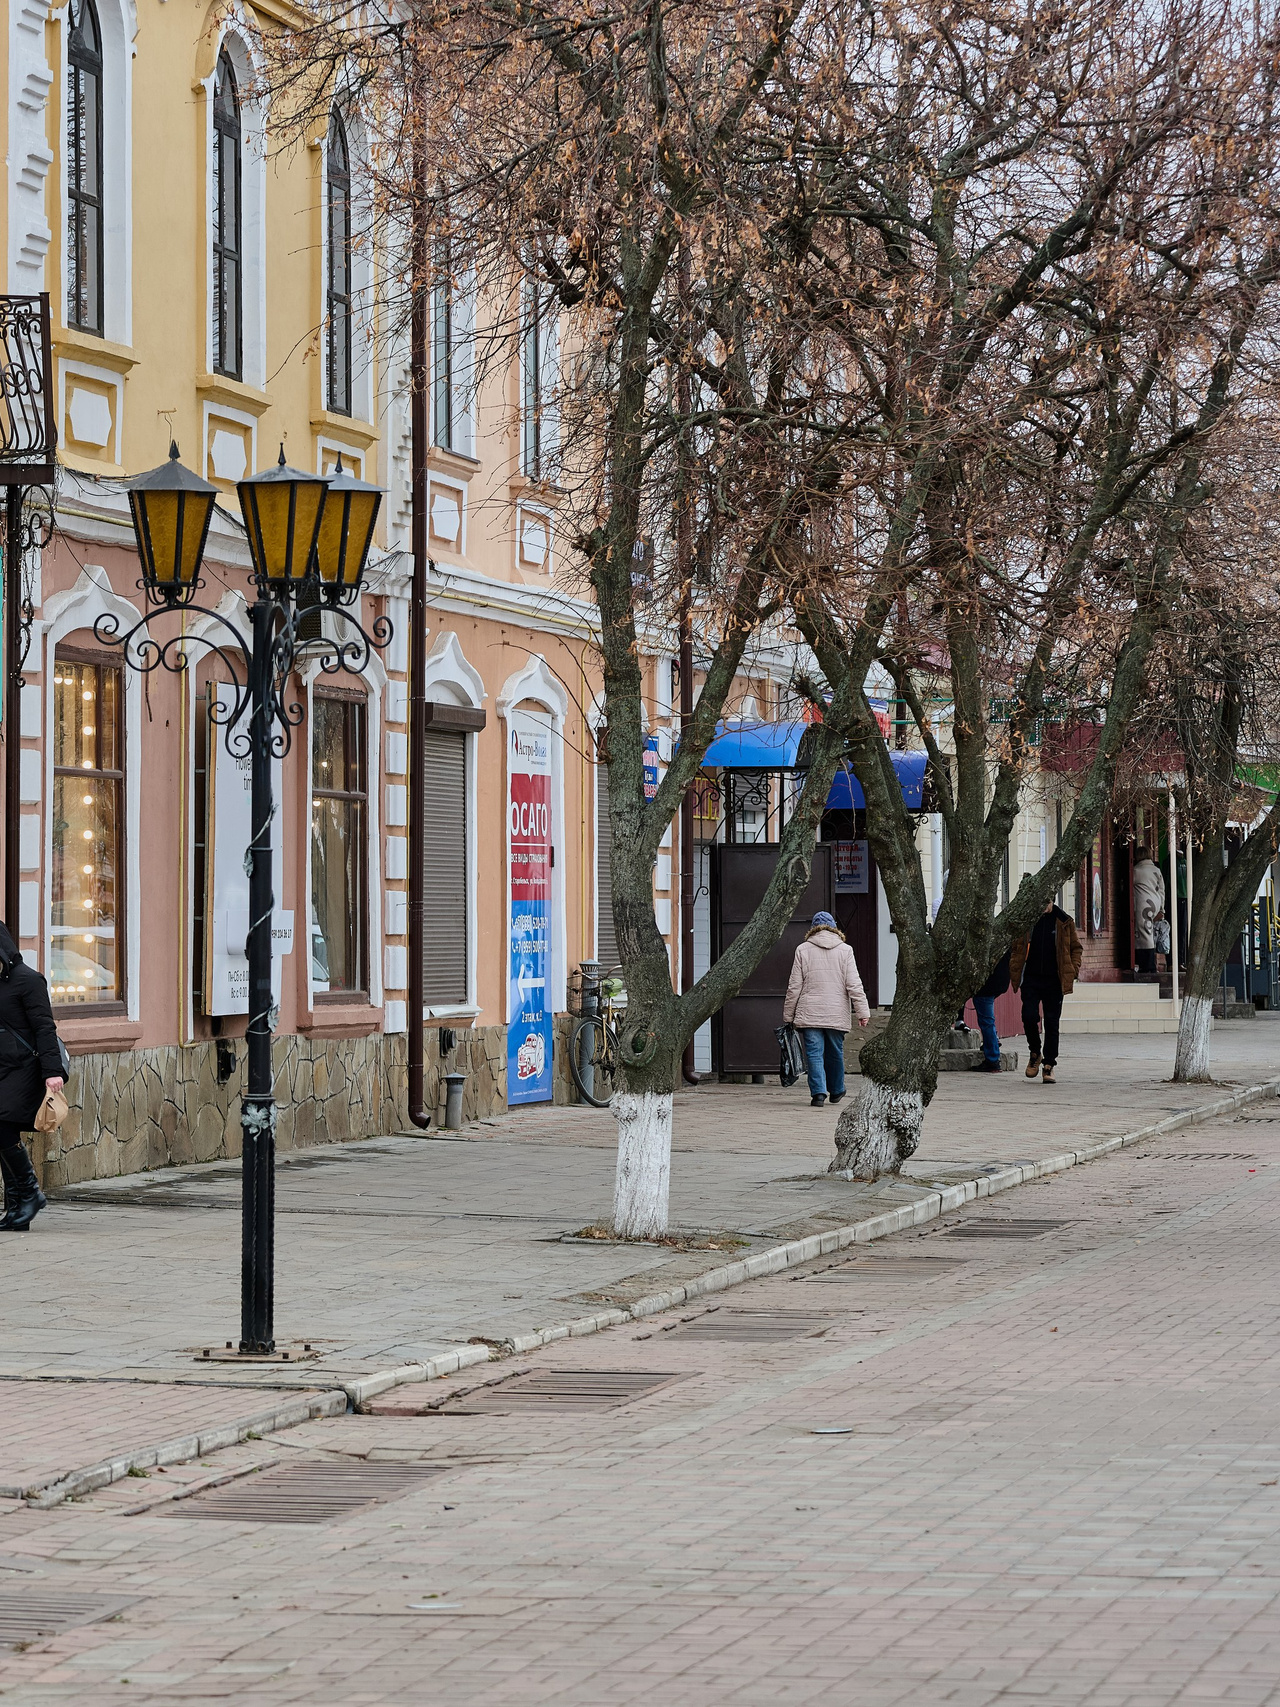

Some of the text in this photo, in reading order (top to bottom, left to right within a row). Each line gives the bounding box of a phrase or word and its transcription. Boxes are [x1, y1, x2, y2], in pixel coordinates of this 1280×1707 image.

[235, 753, 252, 771] Flower
[243, 773, 252, 791] tim
[511, 801, 548, 837] ОСАГО
